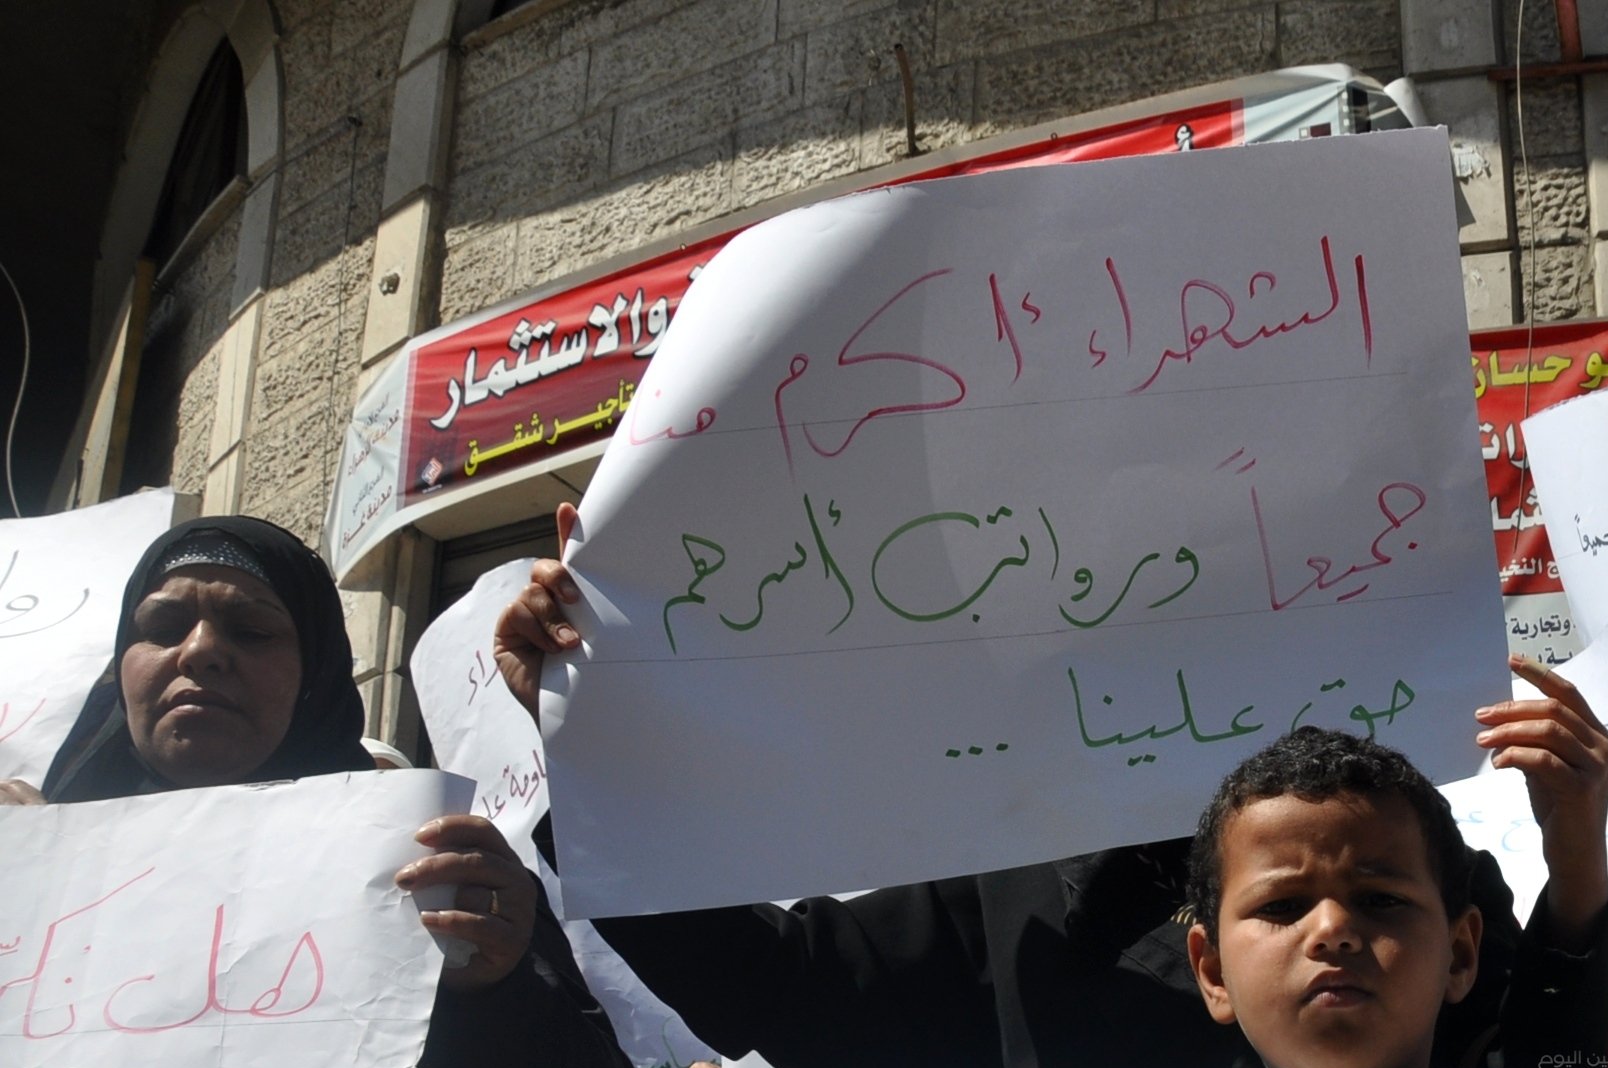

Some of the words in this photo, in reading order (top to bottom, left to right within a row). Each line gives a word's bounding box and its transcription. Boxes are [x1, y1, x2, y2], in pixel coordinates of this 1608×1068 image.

[430, 288, 669, 431] والاستثمار
[775, 268, 1042, 480] أكرم
[464, 412, 545, 477] شقق
[663, 494, 854, 655] أسرهم
[1215, 446, 1427, 612] جميعاً
[1067, 667, 1265, 770] علينا
[102, 903, 326, 1034] هل
